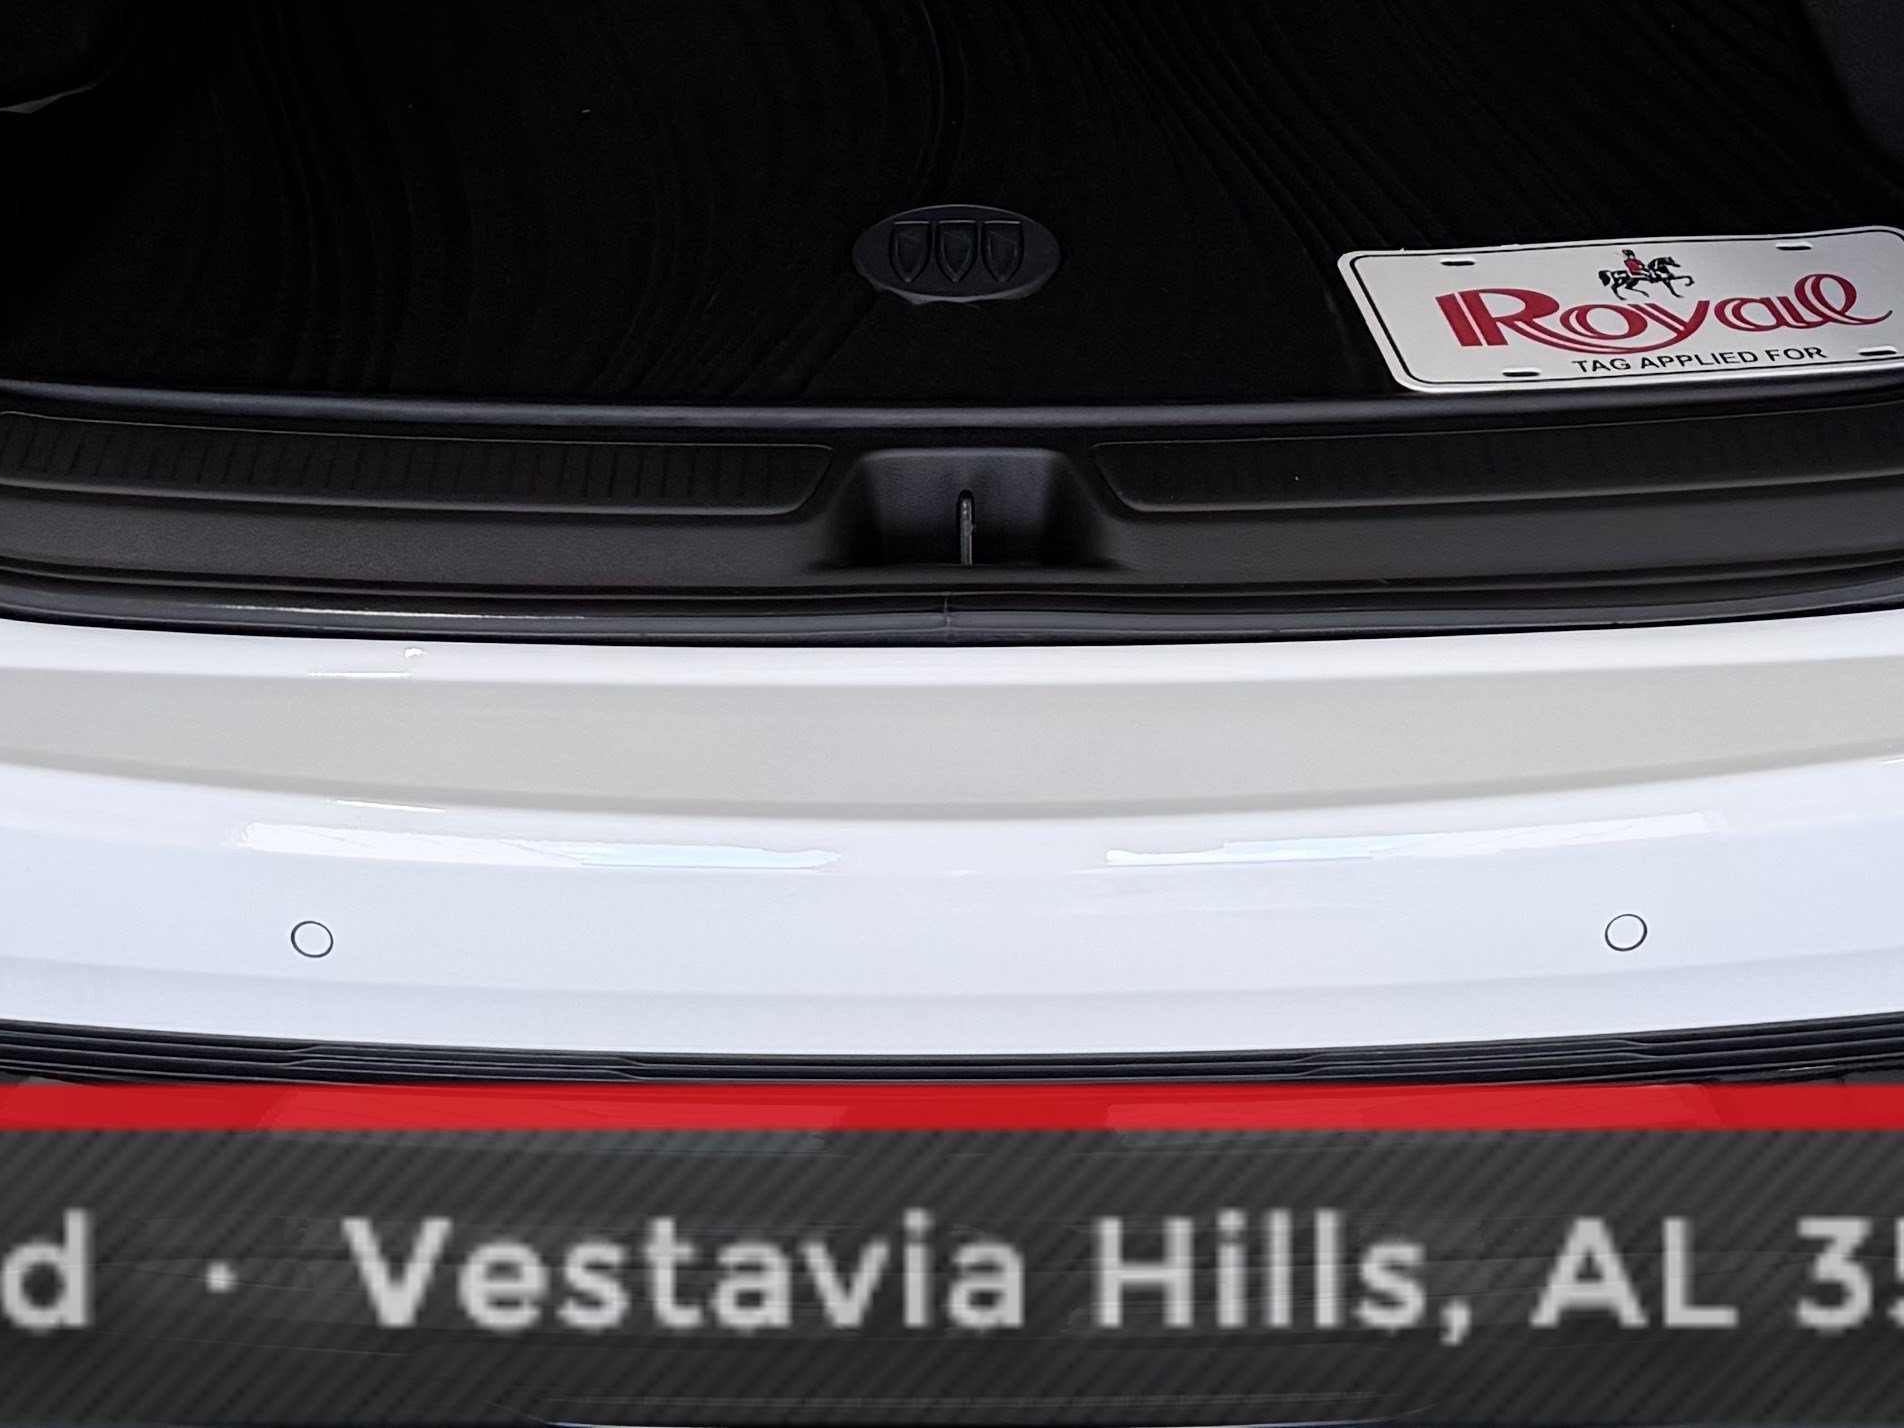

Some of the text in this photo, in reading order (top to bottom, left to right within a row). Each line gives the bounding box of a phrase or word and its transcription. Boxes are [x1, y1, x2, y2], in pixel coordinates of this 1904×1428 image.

[1435, 273, 1893, 356] Royal
[1571, 345, 1828, 373] TAG APPLIED FOR
